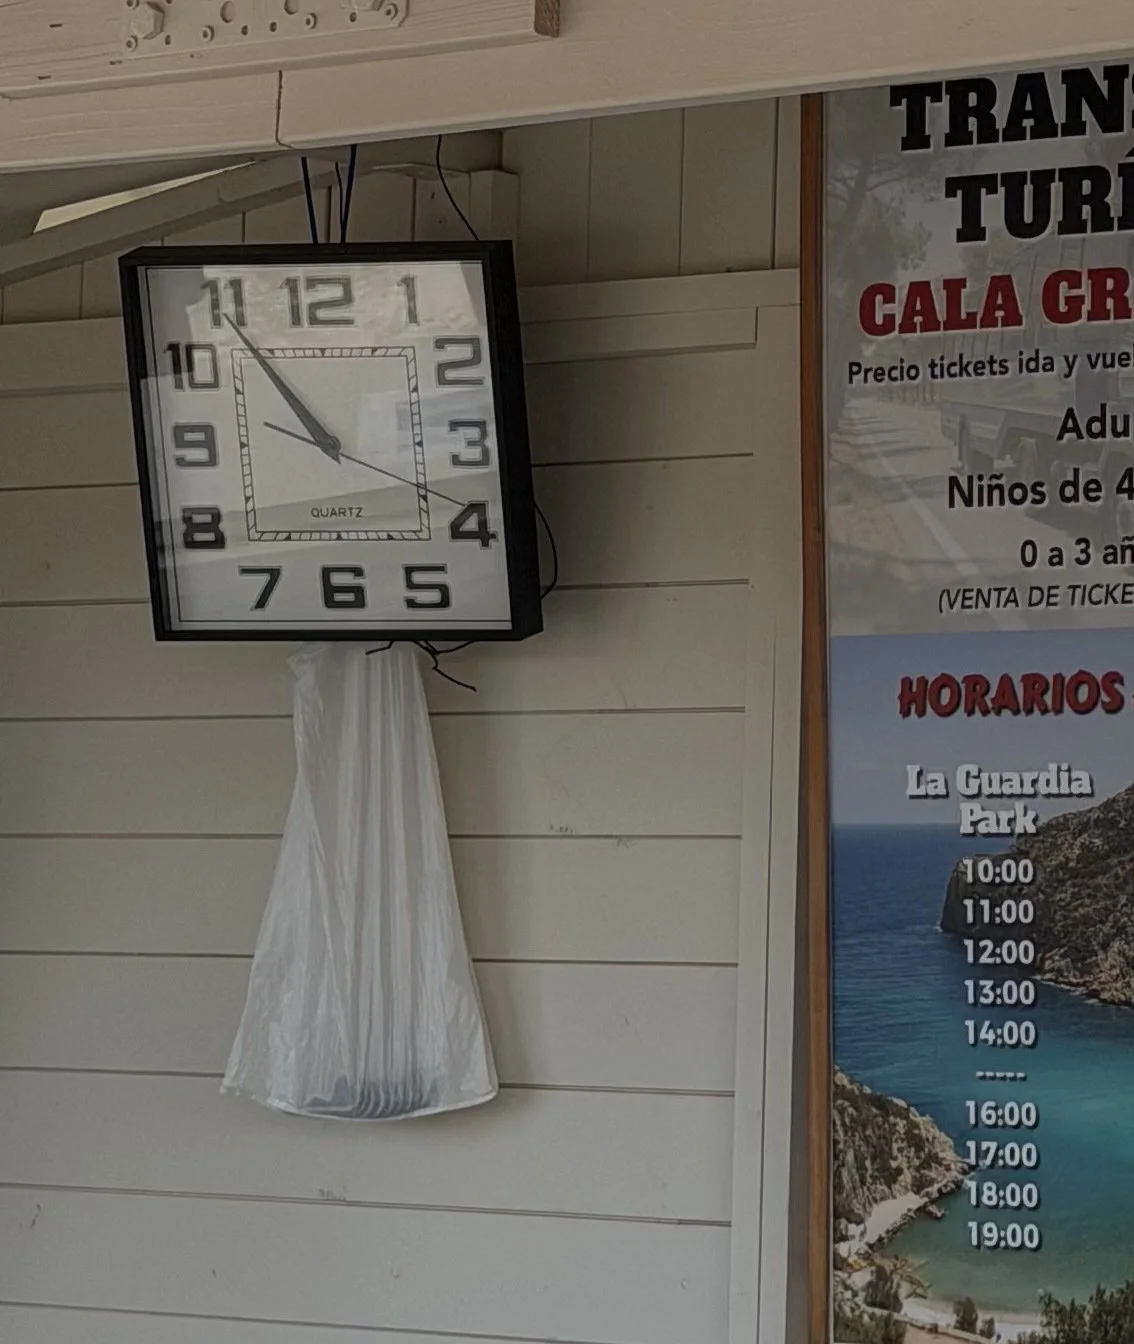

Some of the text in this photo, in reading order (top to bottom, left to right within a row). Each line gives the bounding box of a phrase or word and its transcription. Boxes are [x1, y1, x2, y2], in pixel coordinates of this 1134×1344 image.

[201, 277, 247, 328] 11
[280, 276, 354, 327] 12
[397, 275, 419, 325] 1
[859, 274, 1023, 337] CALA
[164, 342, 219, 390] 10
[433, 336, 484, 386] 2
[848, 359, 920, 384] Precio
[928, 352, 1009, 381] tickets
[1017, 350, 1056, 375] ida
[1063, 356, 1079, 379] y
[173, 423, 218, 467] 9
[449, 419, 490, 467] 3
[947, 469, 1046, 510] Niños
[1059, 468, 1104, 503] de
[182, 506, 226, 549] 8
[311, 506, 364, 518] QUARTZ
[449, 501, 497, 549] 4
[1020, 539, 1038, 569] 0
[1047, 545, 1064, 567] a
[1074, 537, 1092, 567] 3
[238, 567, 281, 610] 7
[321, 565, 366, 608] 6
[404, 564, 451, 608] 5
[938, 587, 1020, 613] (VENTA
[1027, 585, 1060, 609] DE
[898, 670, 1124, 718] HORARIOS
[905, 764, 1091, 797] La Guardia
[959, 803, 1037, 835] Park
[962, 859, 1033, 885] 10:00
[962, 899, 1033, 926] 11:00
[963, 940, 1034, 966] 12:00
[964, 980, 1035, 1006] 13:00
[964, 1021, 1035, 1047] 14:00
[965, 1102, 1037, 1128] 16:00
[966, 1142, 1038, 1168] 17:00
[967, 1182, 1039, 1209] 18:00
[968, 1223, 1040, 1249] 19:00
